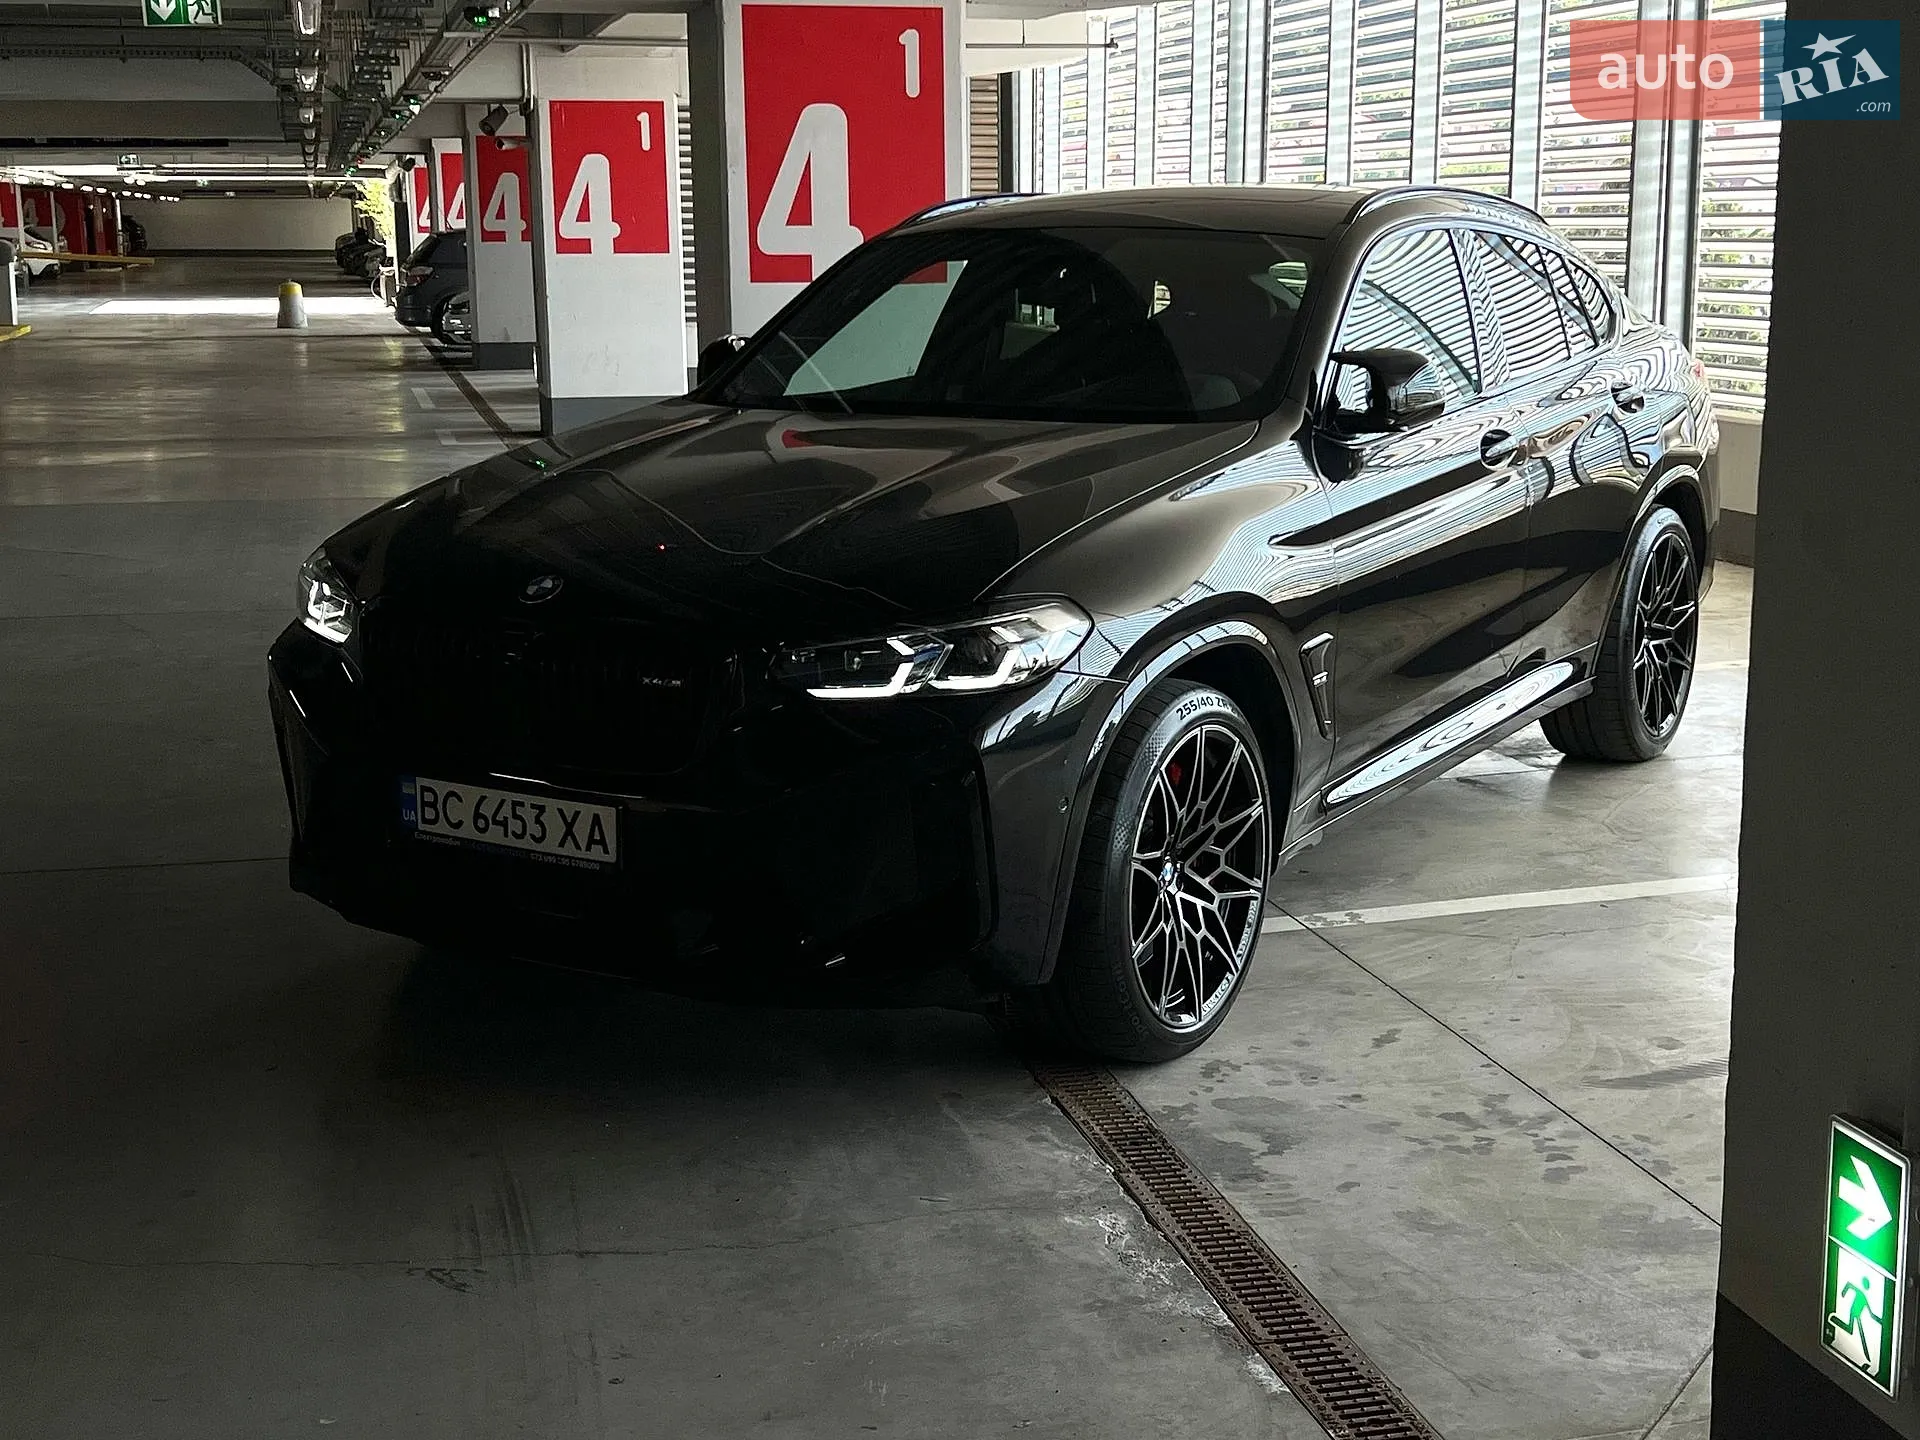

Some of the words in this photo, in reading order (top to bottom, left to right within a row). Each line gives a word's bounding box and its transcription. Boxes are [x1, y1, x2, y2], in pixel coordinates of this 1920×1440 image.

[899, 28, 920, 98] 1
[637, 111, 651, 151] 1
[482, 172, 527, 242] 4
[558, 153, 621, 254] 4
[757, 102, 864, 282] 4
[1176, 696, 1214, 720] 255/40
[402, 808, 417, 824] UA
[419, 784, 464, 830] BC
[472, 795, 548, 844] 6453
[556, 807, 610, 855] XA
